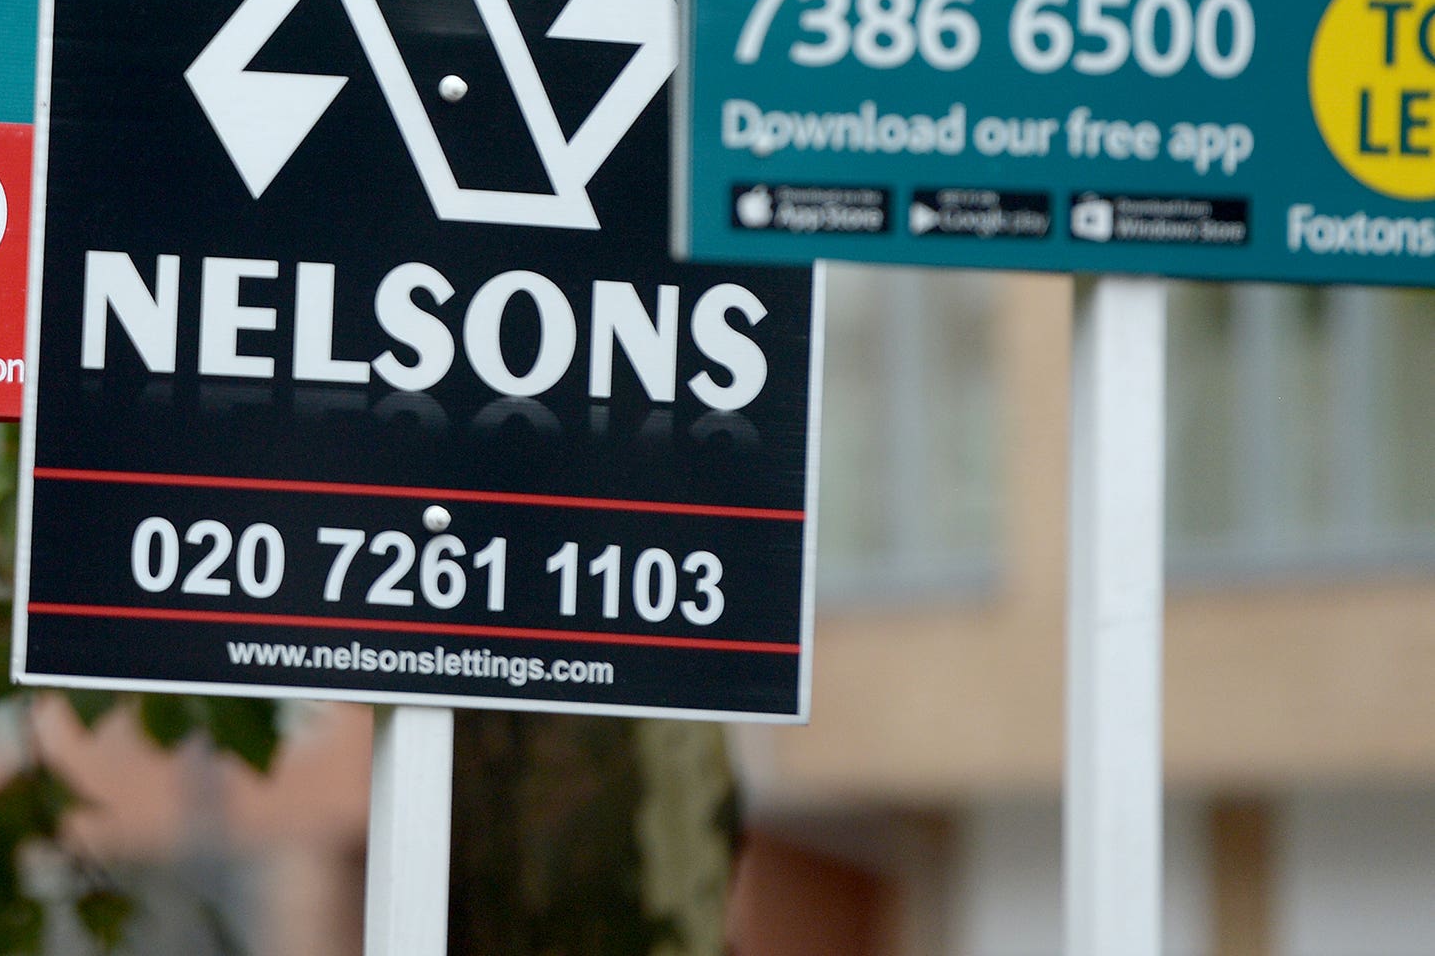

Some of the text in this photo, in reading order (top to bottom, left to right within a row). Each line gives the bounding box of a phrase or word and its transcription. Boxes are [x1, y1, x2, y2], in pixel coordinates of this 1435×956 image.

[722, 99, 1253, 173] Download our free app
[81, 250, 768, 411] NELSONS
[132, 517, 724, 625] 020 7261 1103
[228, 641, 614, 686] www.nelsonslettings.com
